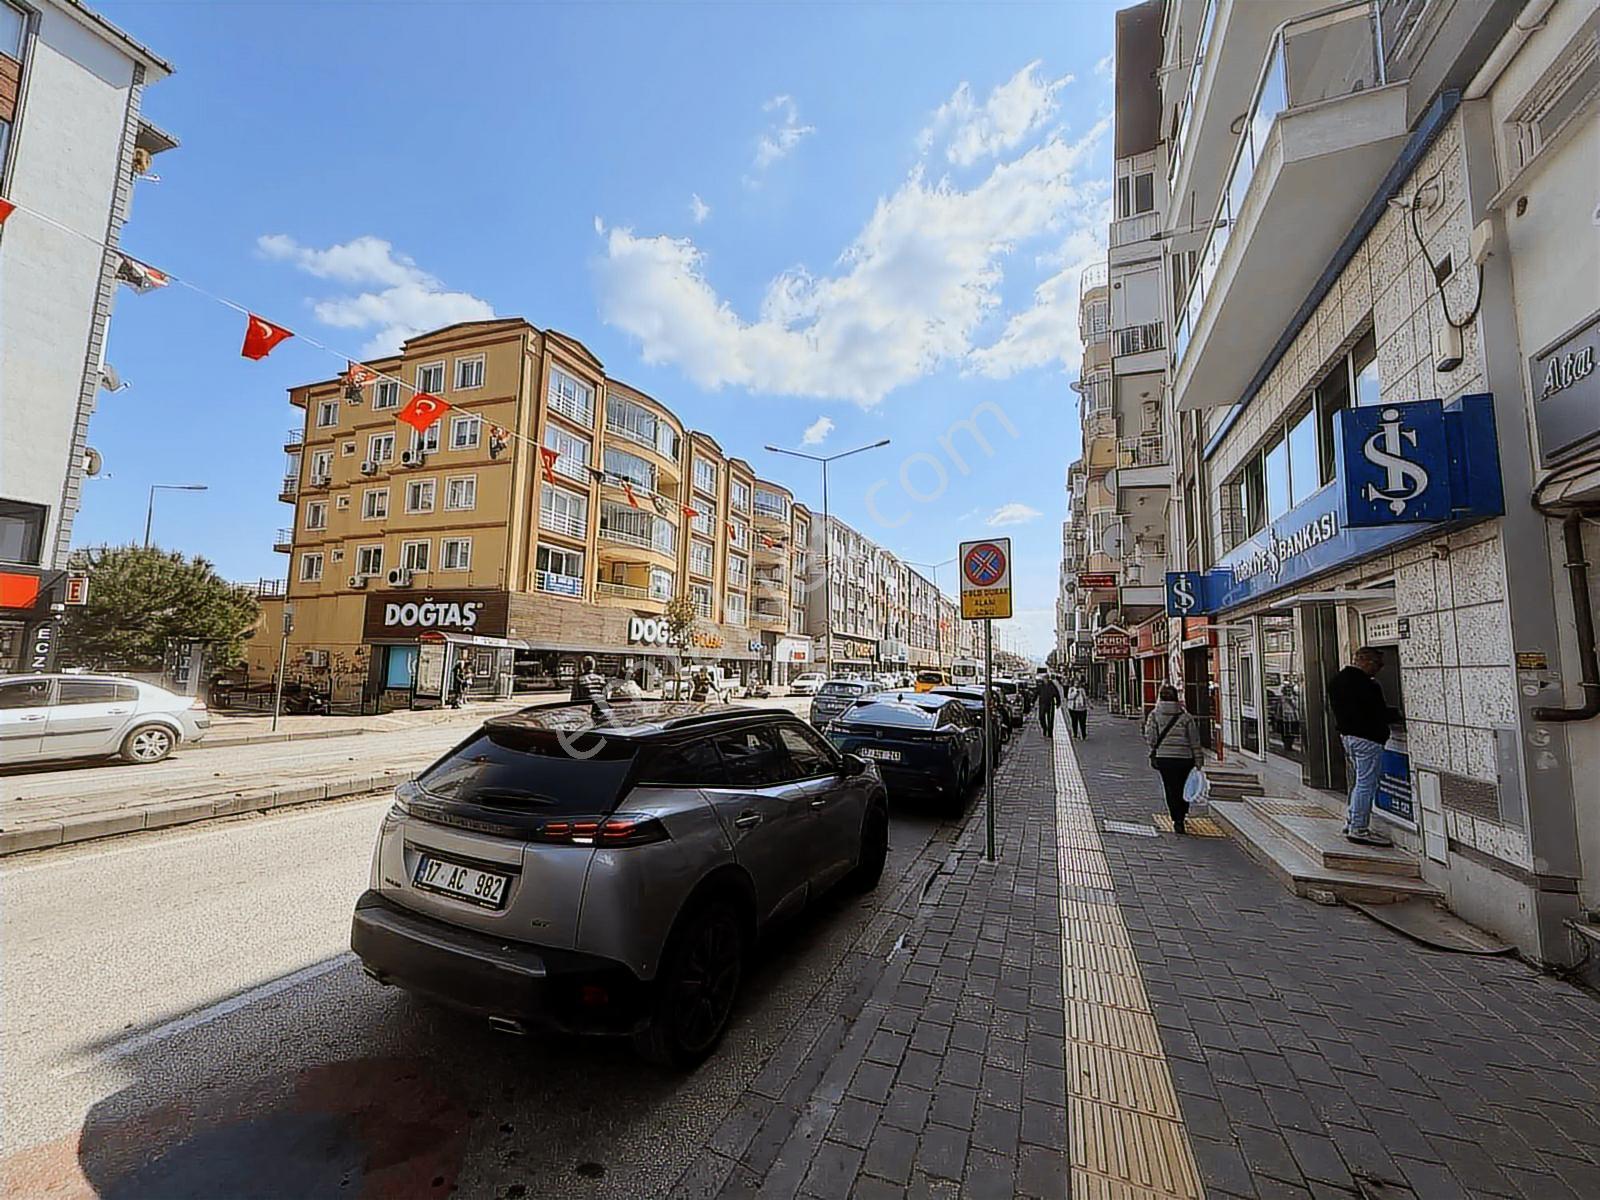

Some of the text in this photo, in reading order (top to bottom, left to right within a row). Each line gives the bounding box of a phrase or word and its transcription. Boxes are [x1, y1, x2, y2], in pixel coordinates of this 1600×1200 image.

[1541, 346, 1594, 401] Ata
[1279, 511, 1337, 561] BANKASI
[31, 628, 51, 674] ECZ
[426, 860, 442, 882] 17
[447, 867, 468, 891] AC
[474, 874, 504, 900] 982
